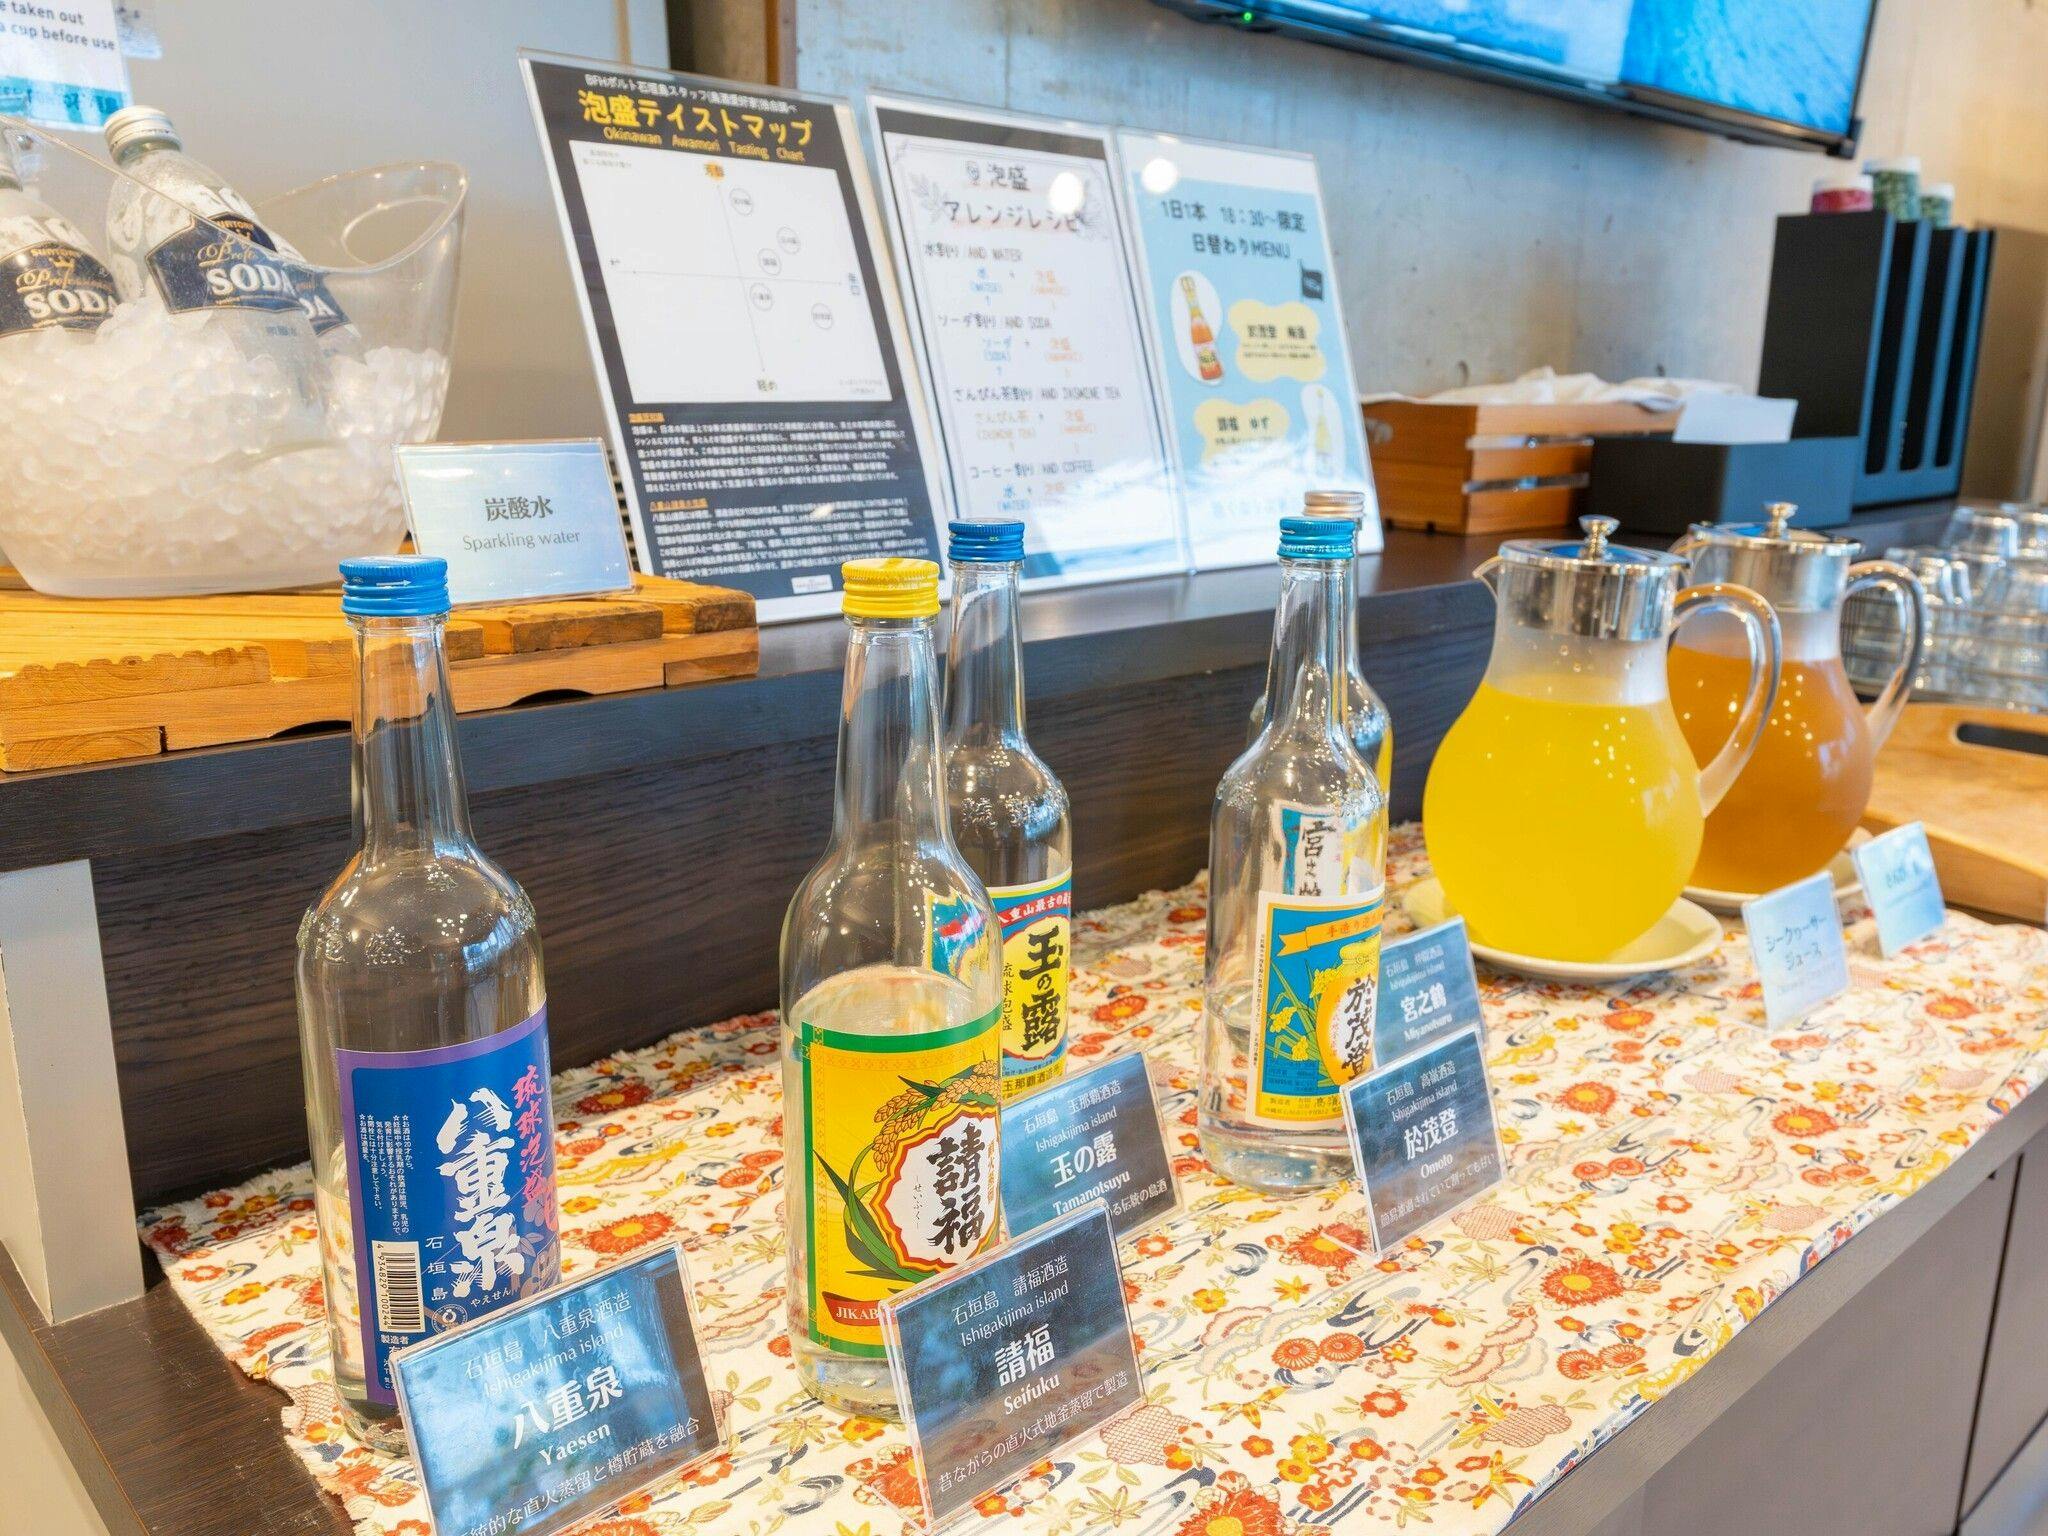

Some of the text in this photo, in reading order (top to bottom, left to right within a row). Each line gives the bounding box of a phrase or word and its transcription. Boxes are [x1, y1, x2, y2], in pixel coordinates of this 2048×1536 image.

[11, 24, 37, 39] cup
[42, 26, 88, 46] before
[92, 38, 115, 50] use
[12, 2, 54, 19] taken
[59, 11, 84, 25] out
[577, 88, 813, 146] 泡盛テイストマップ
[603, 126, 662, 145] Okinawan
[729, 141, 770, 160] Tasting
[776, 146, 806, 162] Chart
[1192, 233, 1291, 258] 日替わりMENU
[206, 263, 300, 296] SODA
[484, 495, 554, 522] 炭酸水
[463, 530, 581, 553] Sparkling water
[1018, 924, 1064, 1052] 玉の露
[1385, 1081, 1415, 1106] 石垣島
[1391, 1079, 1459, 1122] Ishigakijima island
[1023, 1108, 1060, 1135] 石垣島
[1036, 1105, 1118, 1153] Ishigakijima island
[1403, 1107, 1459, 1161] 於茂登
[1049, 1130, 1118, 1189] 玉の露
[1420, 1154, 1454, 1179] Omoto
[436, 1087, 526, 1299] 八重泉
[925, 1121, 986, 1255] 請福
[1052, 1169, 1131, 1217] Tamanotsuyu
[424, 1235, 449, 1302] 石垣島
[952, 1254, 1070, 1326] 石垣島 請福酒造
[470, 1287, 512, 1308] やえせん
[961, 1280, 1069, 1348] Ishigakijima island
[463, 1340, 524, 1380] 石垣島
[541, 1291, 633, 1347] 八重泉酒造
[994, 1322, 1056, 1388] 請福
[484, 1323, 624, 1399] Ishigakijima island
[513, 1364, 624, 1451] 八重泉
[1003, 1374, 1061, 1415] Seifuku
[538, 1422, 611, 1467] Yaesen
[938, 1371, 1129, 1493] 昔ながらの直火式地釜蒸留で製造
[458, 1416, 701, 1536] 統的な直火蒸留と樽貯蔵を融合
